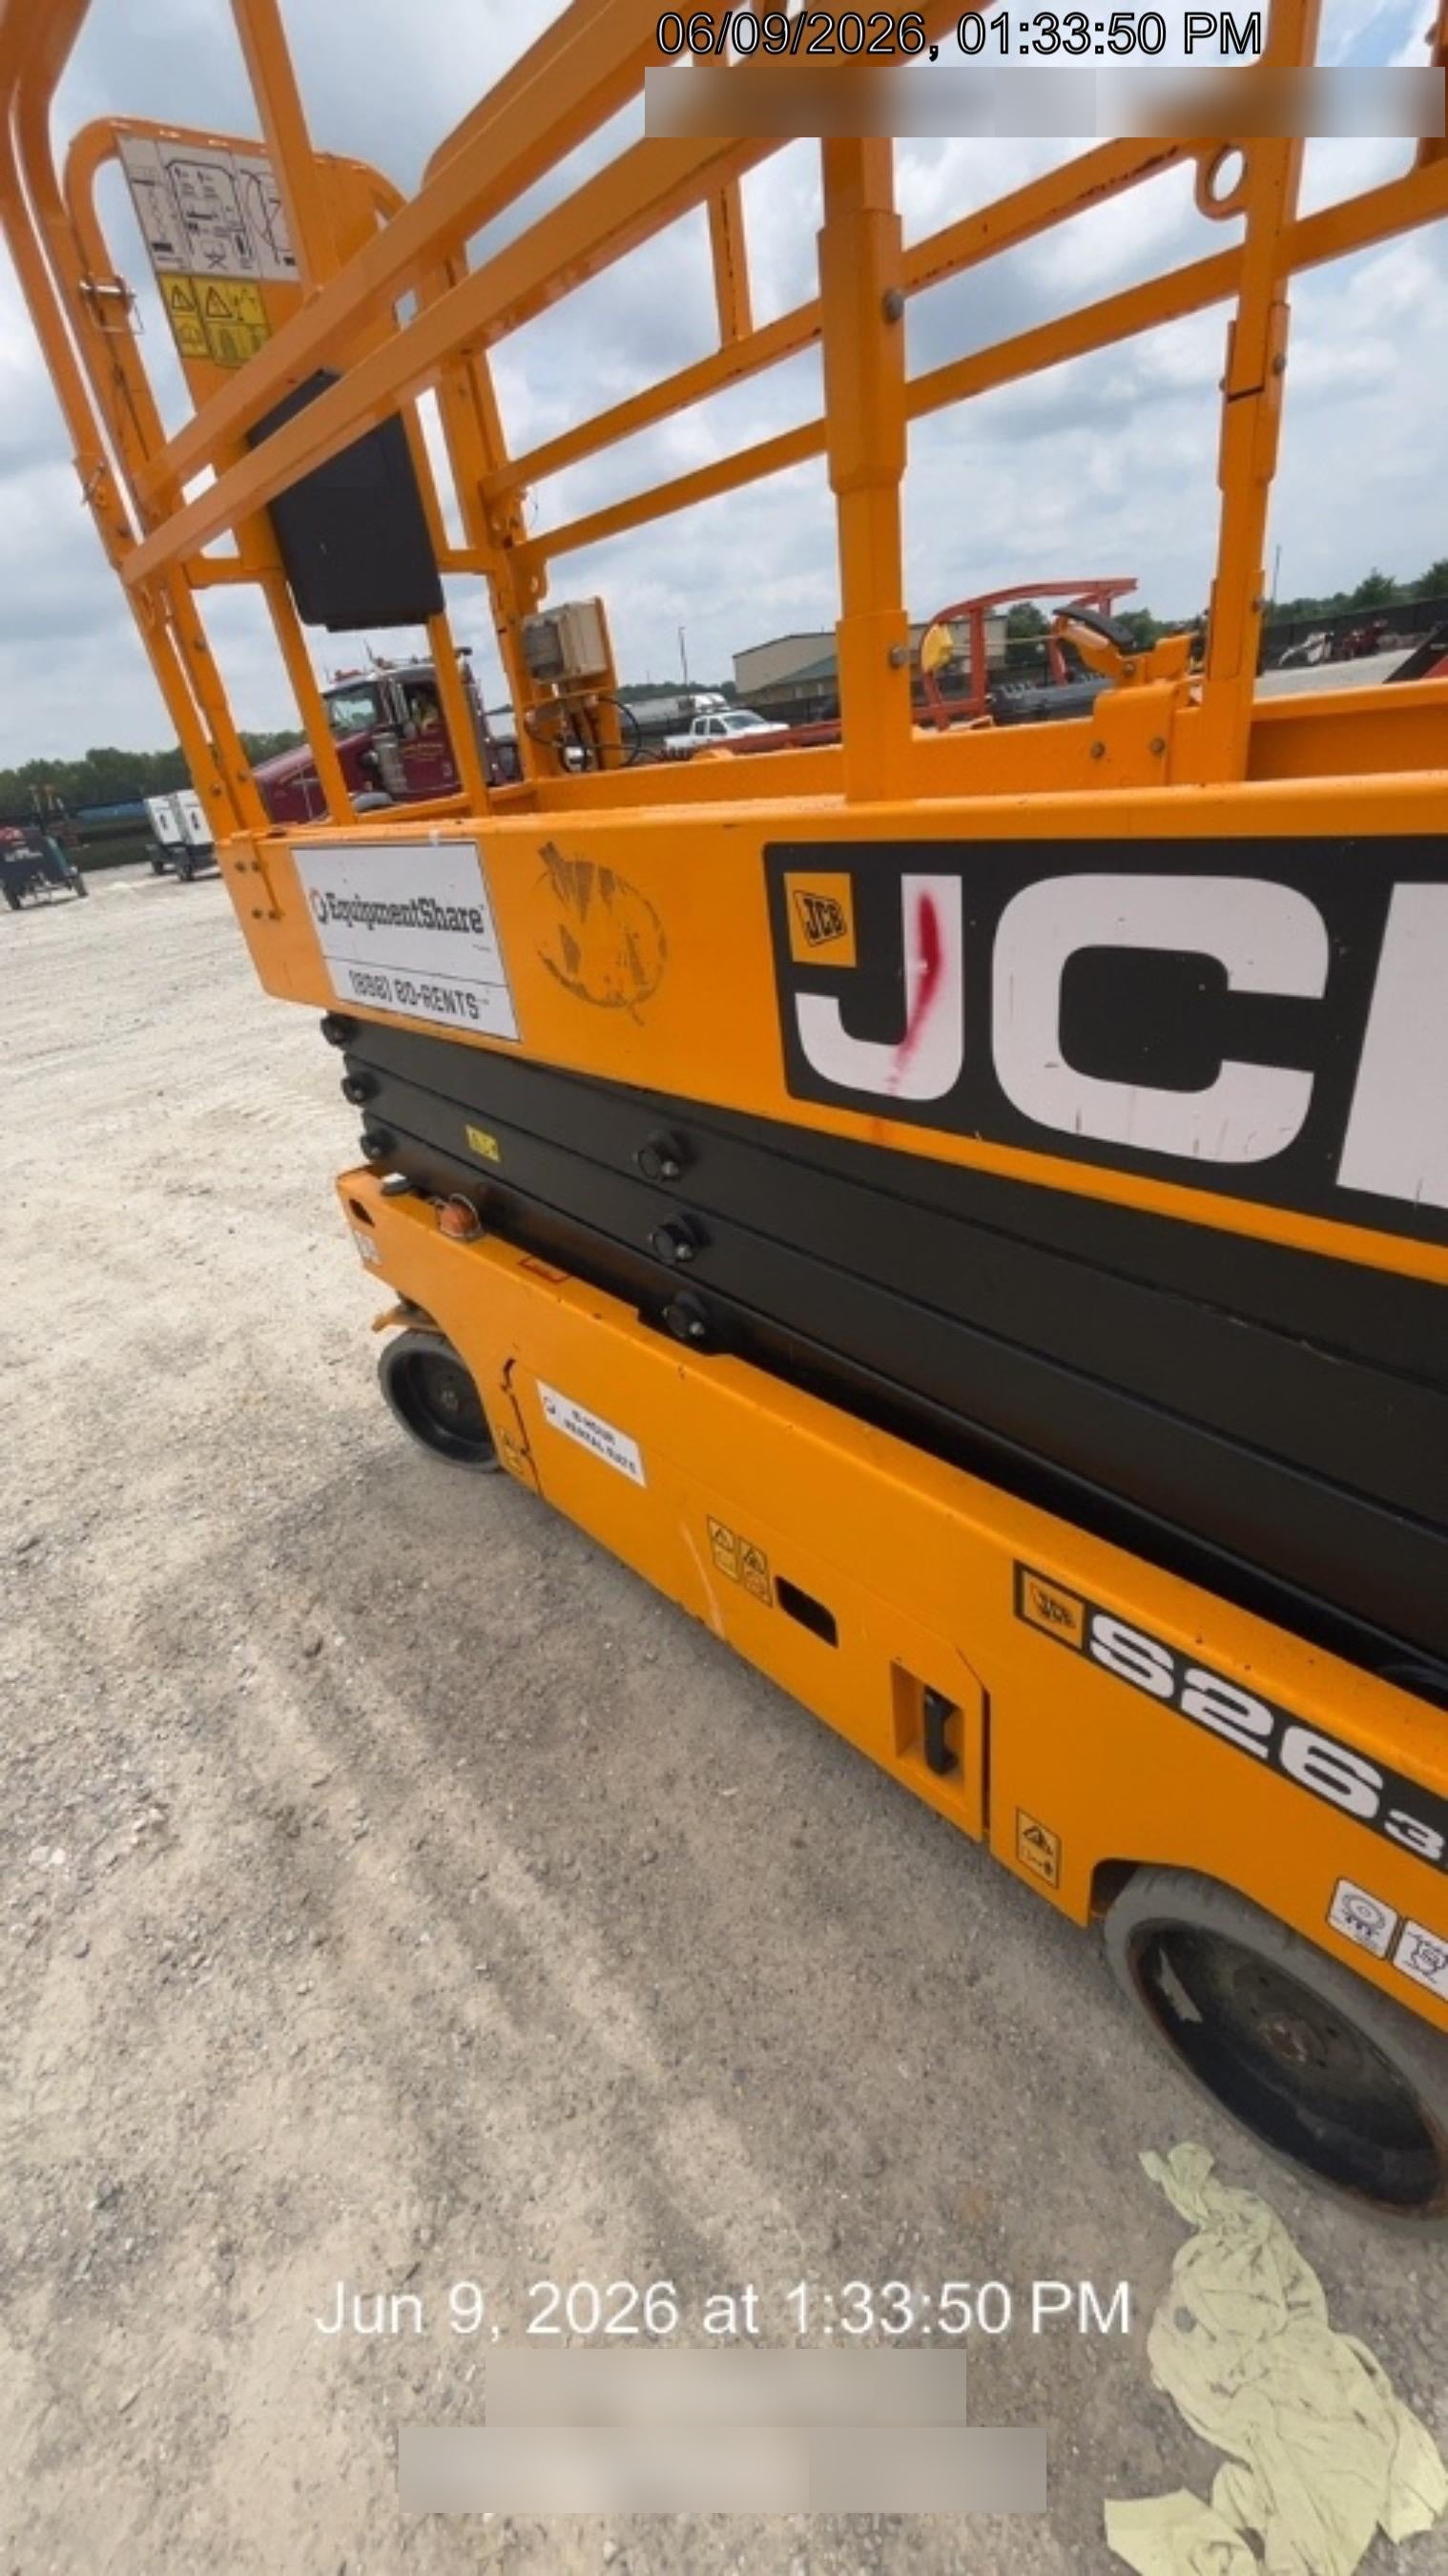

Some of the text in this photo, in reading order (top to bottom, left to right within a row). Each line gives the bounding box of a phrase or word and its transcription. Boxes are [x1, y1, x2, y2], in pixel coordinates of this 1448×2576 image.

[325, 892, 484, 934] EquipmentShare
[803, 897, 843, 940] JCB
[795, 872, 1448, 1209] JC
